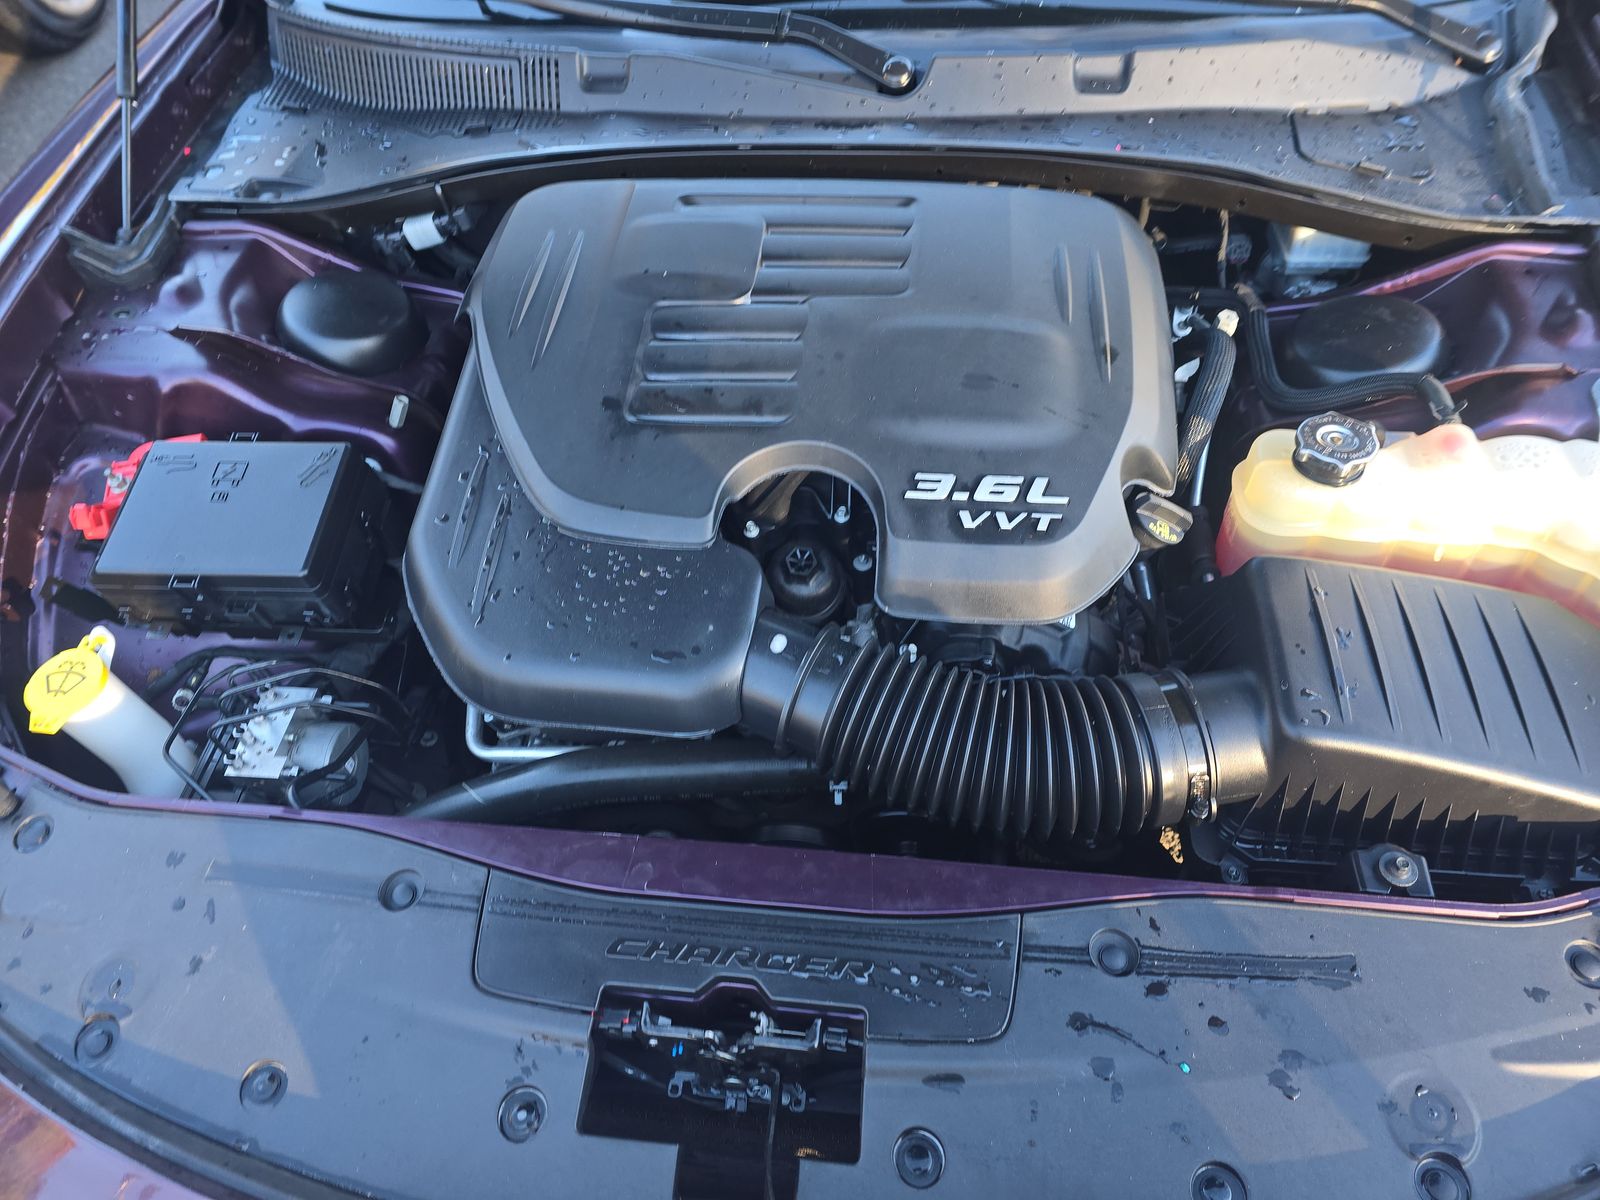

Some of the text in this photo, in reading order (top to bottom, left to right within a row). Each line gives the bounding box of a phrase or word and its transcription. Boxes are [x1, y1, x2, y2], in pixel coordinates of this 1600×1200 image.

[904, 472, 1070, 505] 3.6L
[957, 509, 1064, 532] VVT
[605, 937, 874, 984] CHARGER
